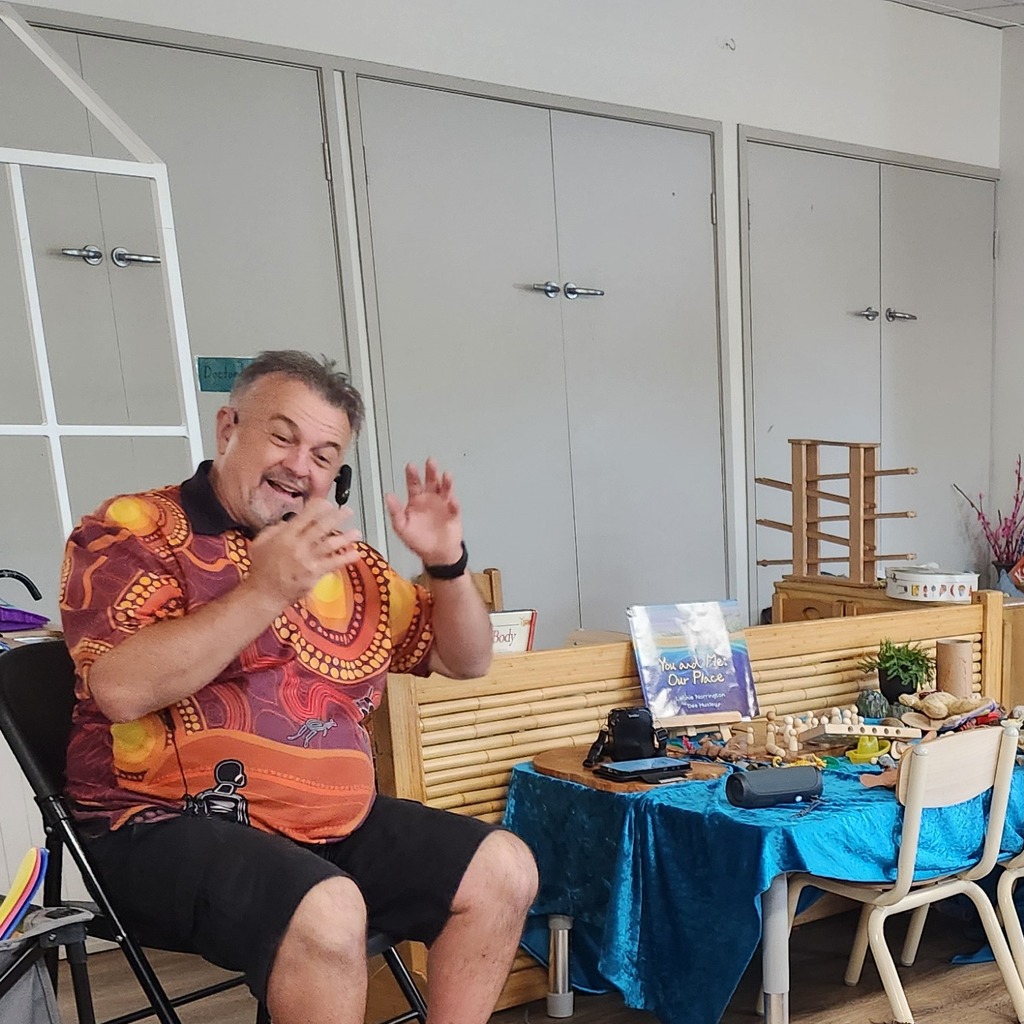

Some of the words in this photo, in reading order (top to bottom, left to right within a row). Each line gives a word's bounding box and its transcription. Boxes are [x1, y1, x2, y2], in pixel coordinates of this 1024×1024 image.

[493, 628, 517, 646] Body
[658, 657, 677, 671] You
[679, 656, 703, 670] and
[706, 654, 728, 668] Me:
[668, 673, 690, 686] Our
[693, 671, 725, 685] Place
